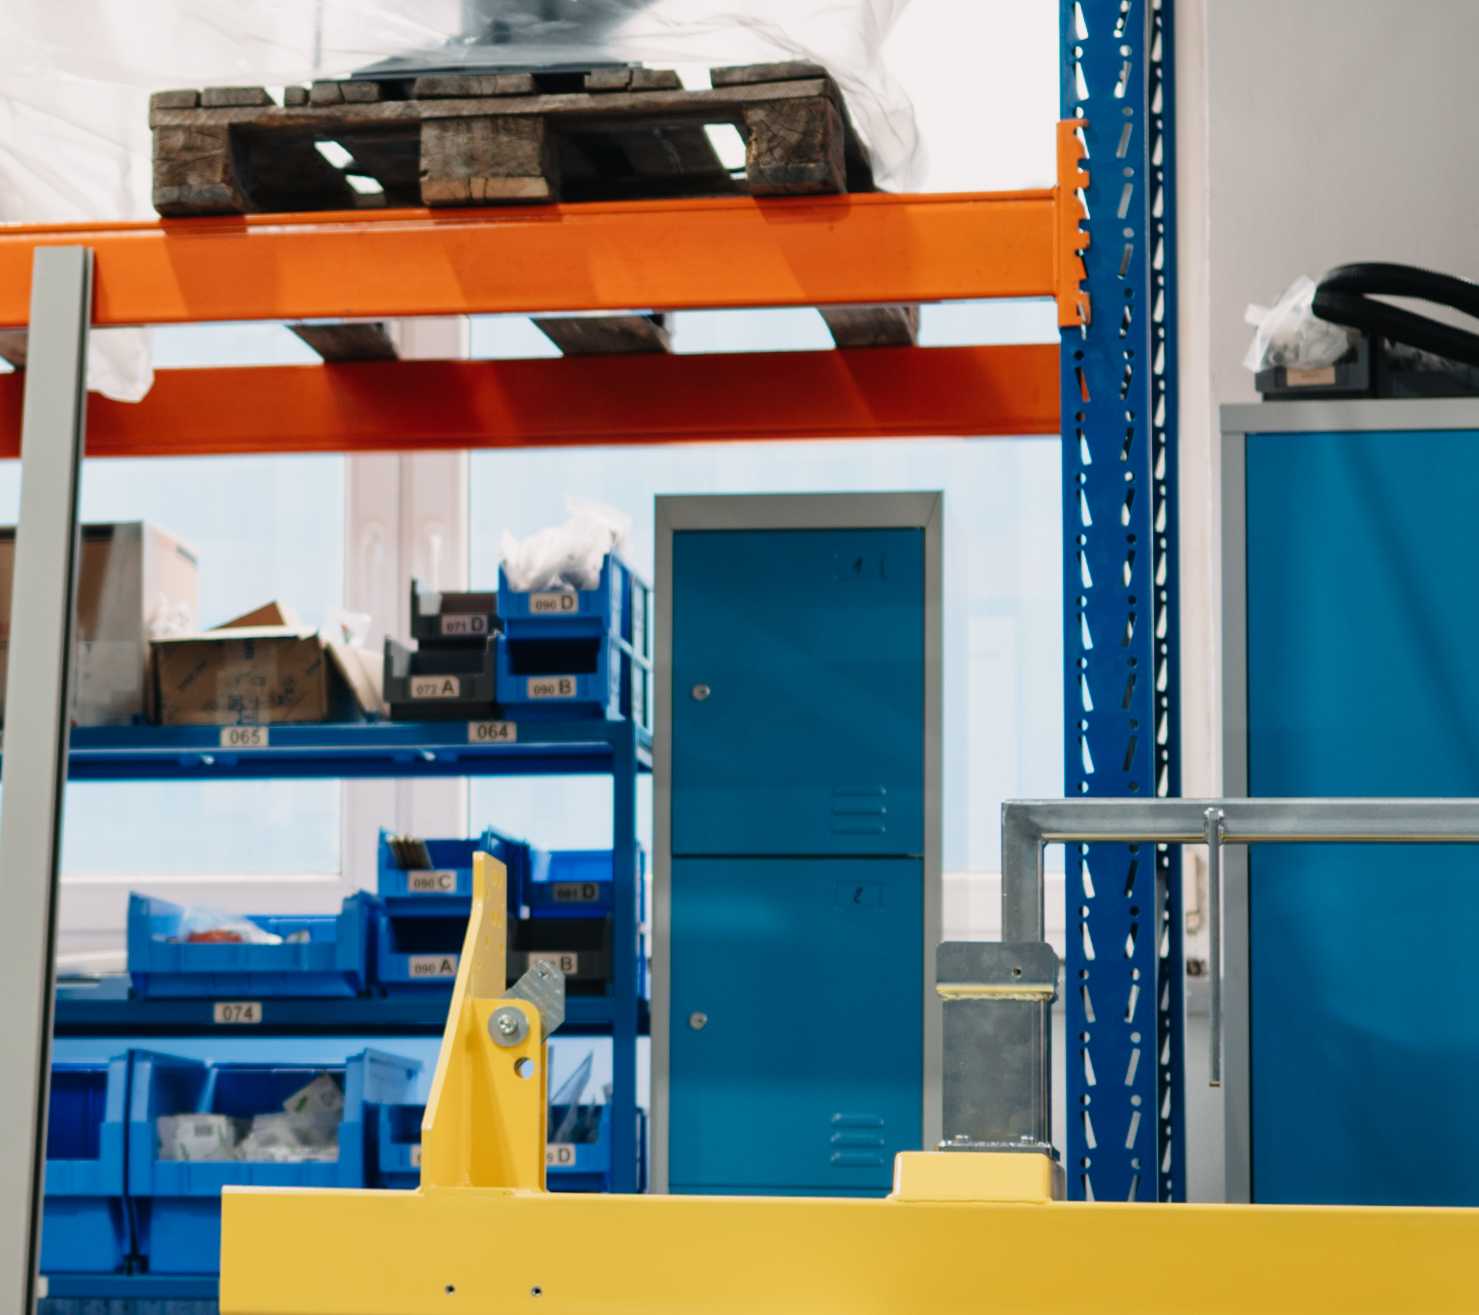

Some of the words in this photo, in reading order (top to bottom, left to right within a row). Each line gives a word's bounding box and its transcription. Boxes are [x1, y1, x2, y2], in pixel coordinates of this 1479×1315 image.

[562, 594, 573, 611] D
[471, 616, 483, 632] D
[416, 685, 438, 695] 072
[442, 679, 455, 694] A
[559, 679, 571, 694] B
[229, 729, 261, 744] 065
[477, 724, 509, 740] 064
[438, 874, 452, 889] C
[440, 959, 452, 974] A
[560, 956, 572, 972] B
[223, 1007, 252, 1021] 074
[558, 1147, 571, 1163] D
